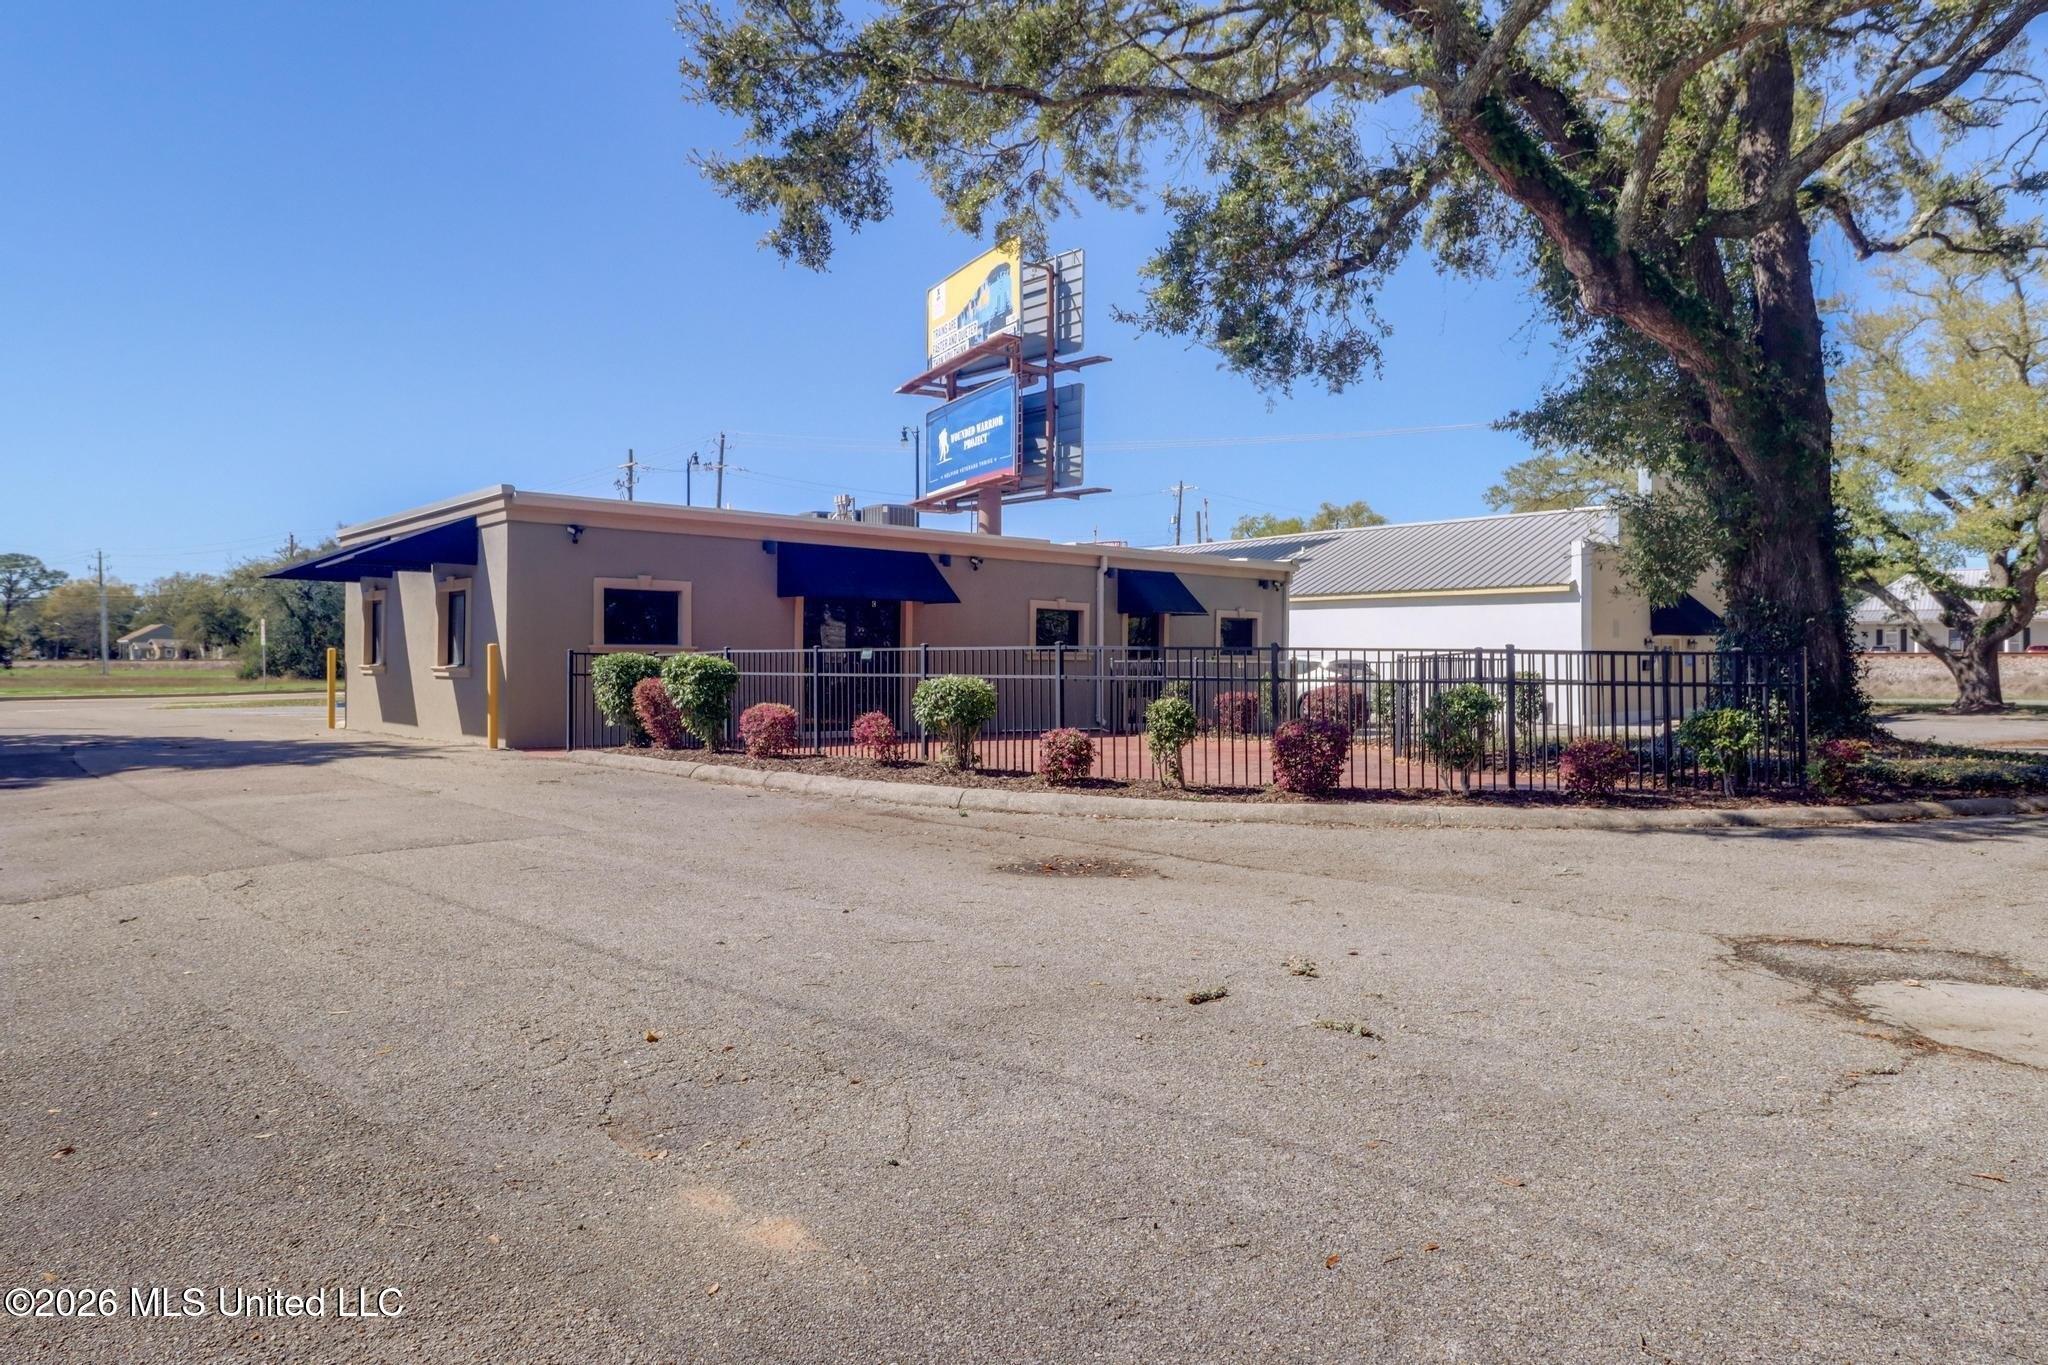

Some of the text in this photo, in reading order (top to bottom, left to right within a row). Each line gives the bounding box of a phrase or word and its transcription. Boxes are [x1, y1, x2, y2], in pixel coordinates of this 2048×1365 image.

[932, 318, 957, 337] TRAINS ARE
[932, 322, 977, 353] FASTER AND QUIETER
[950, 415, 1003, 443] WOUNDED WARRIOR
[963, 432, 988, 450] PROJECT
